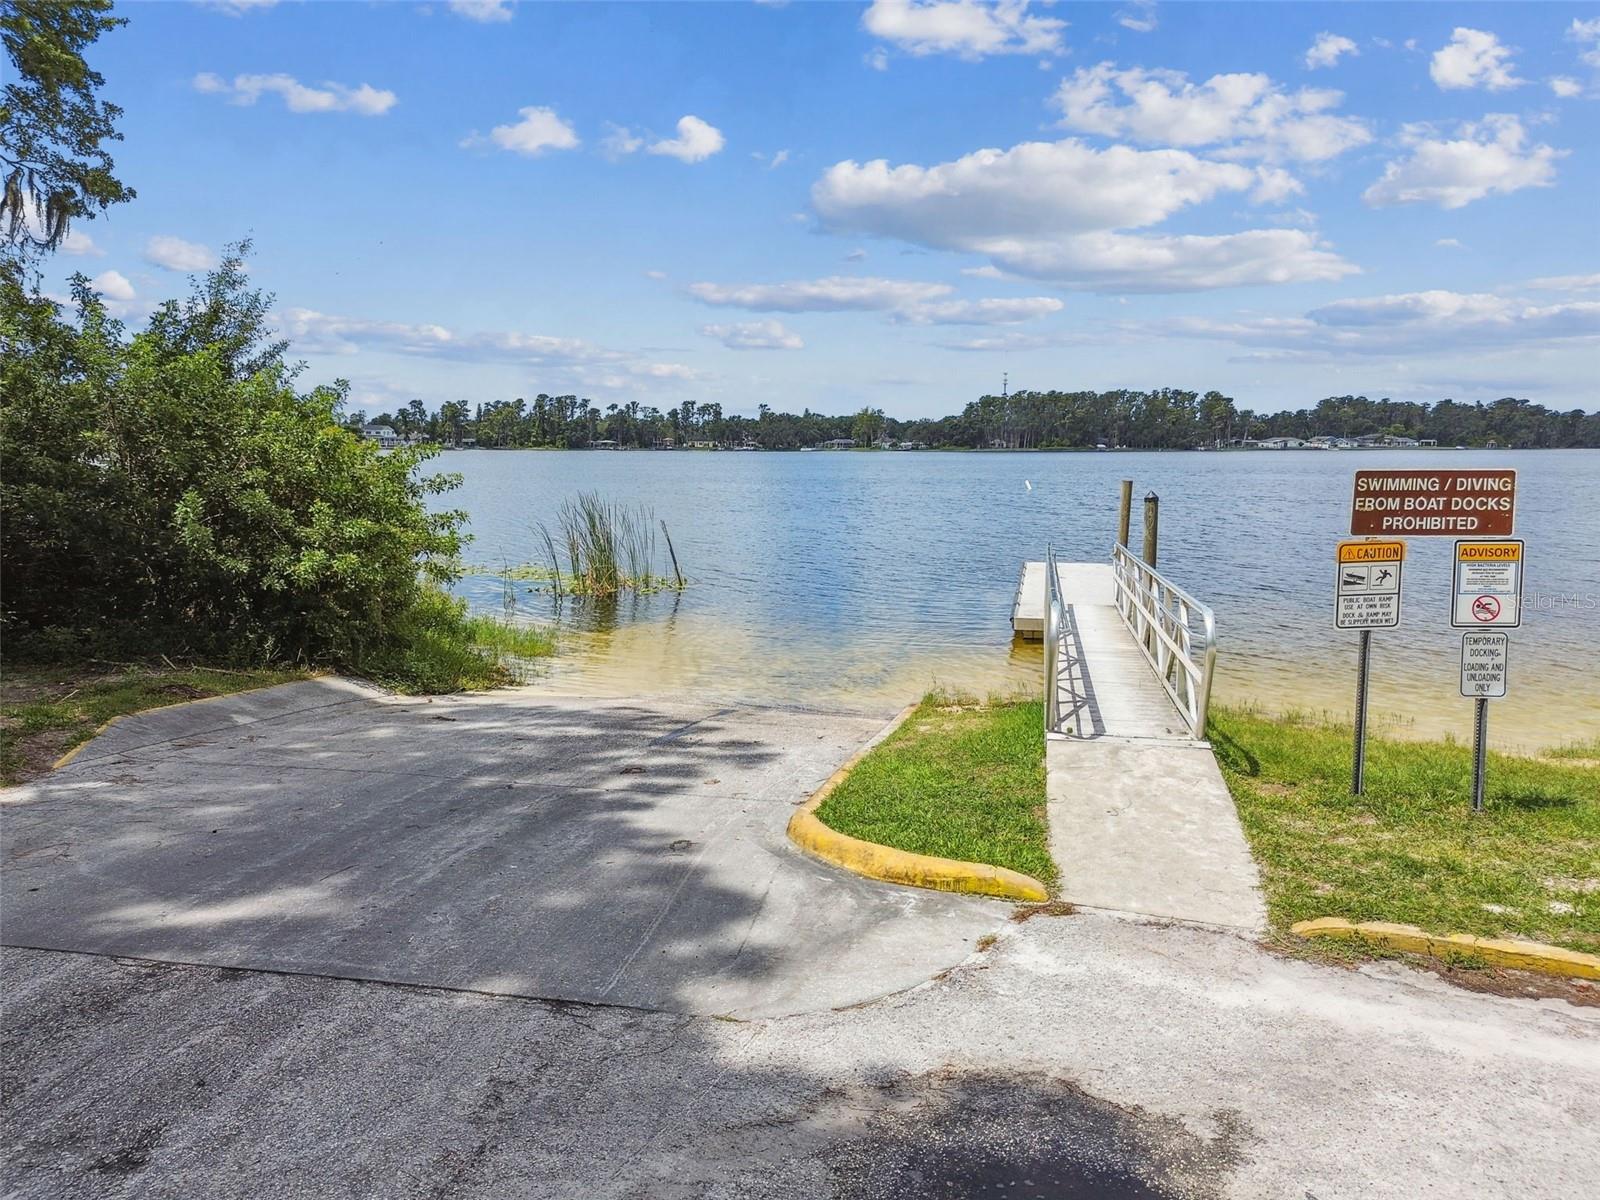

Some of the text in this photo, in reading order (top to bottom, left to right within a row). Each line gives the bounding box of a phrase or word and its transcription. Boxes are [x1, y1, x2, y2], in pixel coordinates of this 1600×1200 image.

[1357, 478, 1512, 491] SWIMMING / DIVING
[1355, 497, 1511, 511] FROM BOAT DOCKS
[1382, 516, 1478, 530] PROHIBITED
[1357, 547, 1399, 559] CAUTION
[1461, 548, 1517, 557] ADVISORY
[1465, 636, 1505, 646] TEMPORARY
[1470, 648, 1499, 657] DOCKING
[1464, 662, 1504, 671] LOADING AND
[1467, 673, 1501, 681] UNLOADING
[1475, 683, 1490, 692] ONLY
